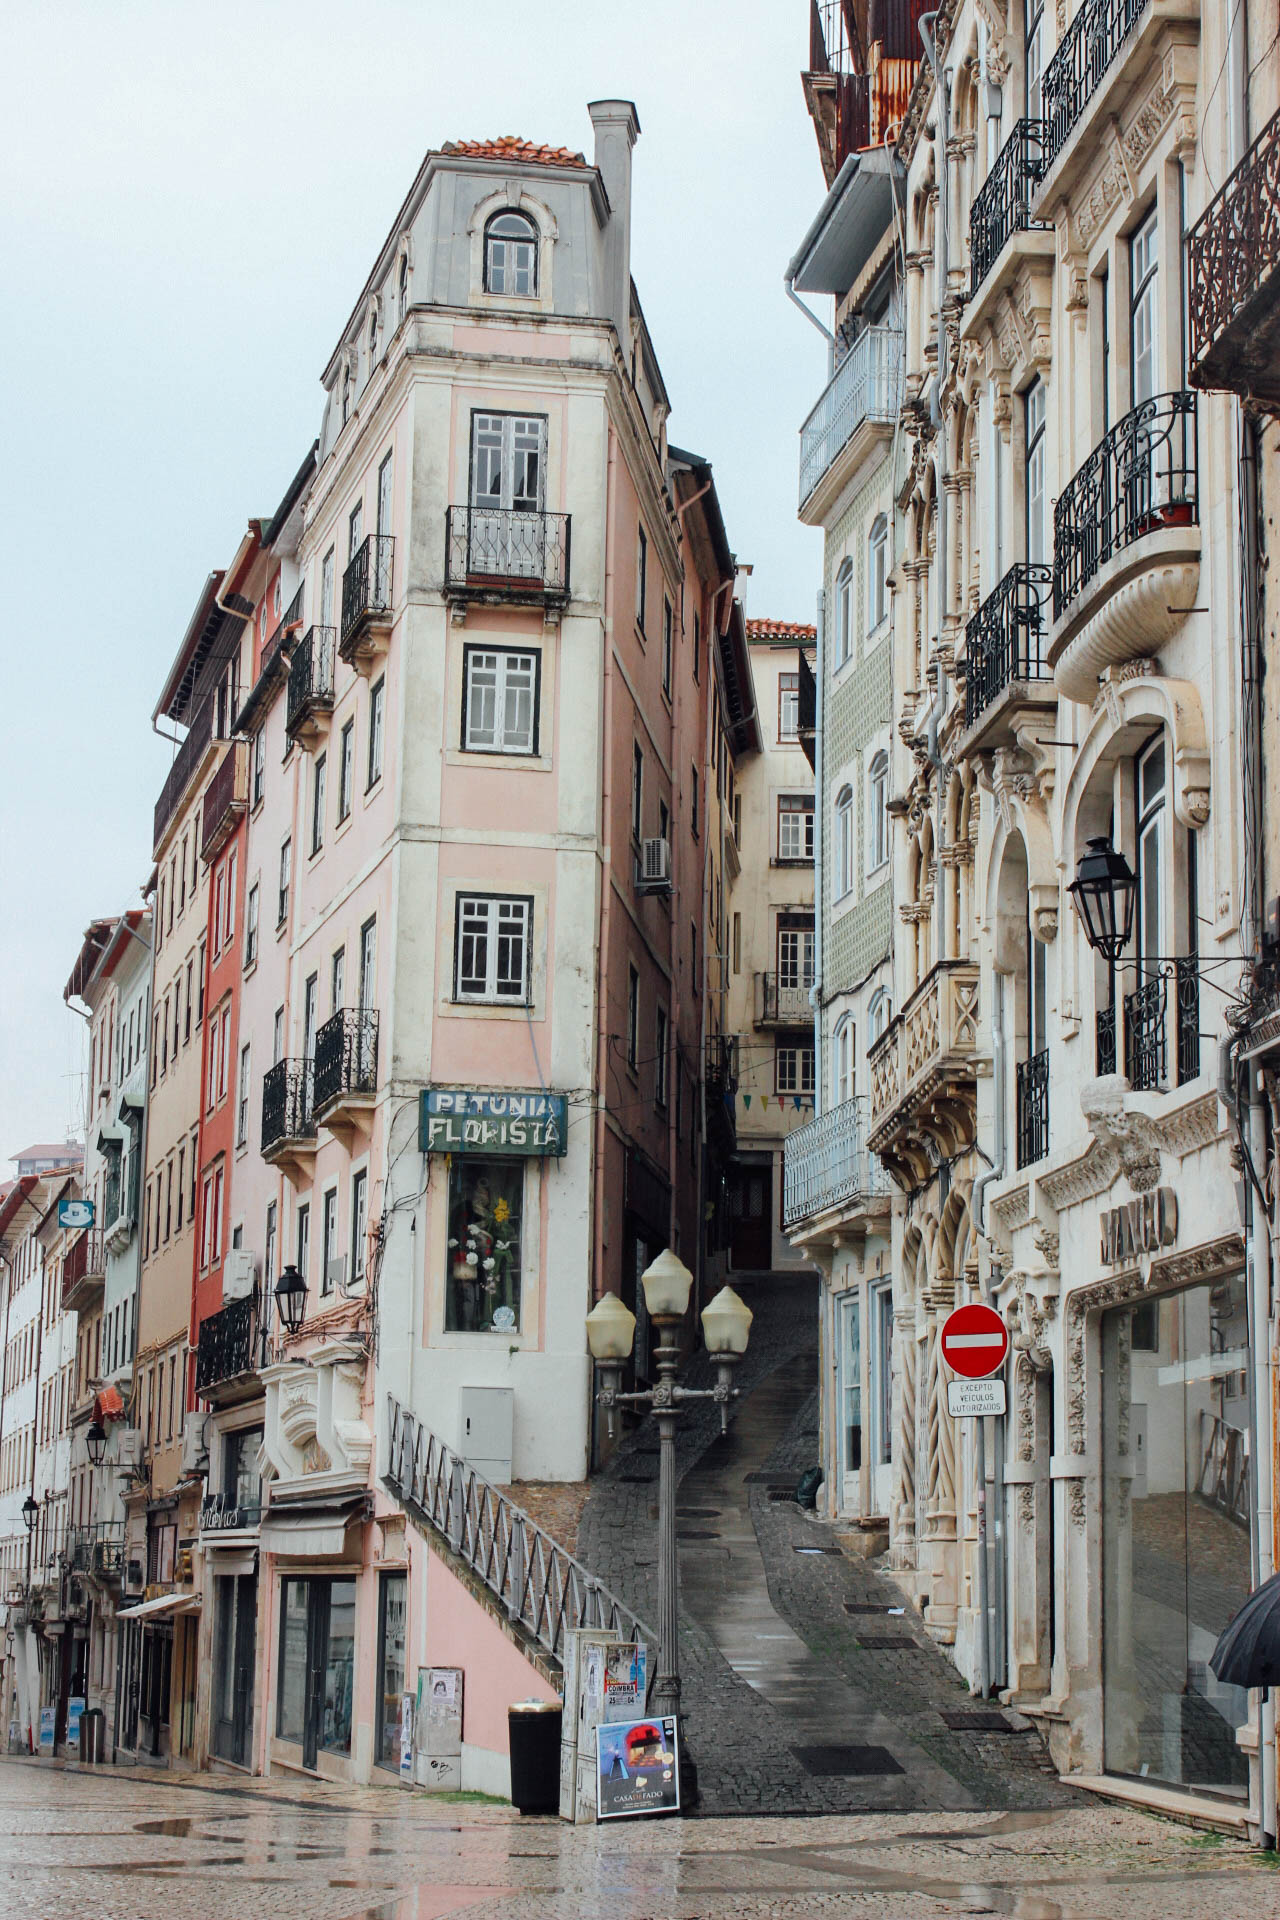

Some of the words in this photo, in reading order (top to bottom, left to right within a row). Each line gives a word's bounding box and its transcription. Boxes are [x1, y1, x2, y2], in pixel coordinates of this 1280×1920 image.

[428, 1117, 560, 1149] FLORISTA
[1100, 1186, 1179, 1266] MANGO
[960, 1383, 993, 1392] EXCEPTO
[951, 1402, 1001, 1412] AUTORIZADOS
[609, 1696, 616, 1704] 25
[627, 1696, 635, 1704] 04
[613, 1793, 633, 1803] CASA
[642, 1790, 663, 1800] FADO
